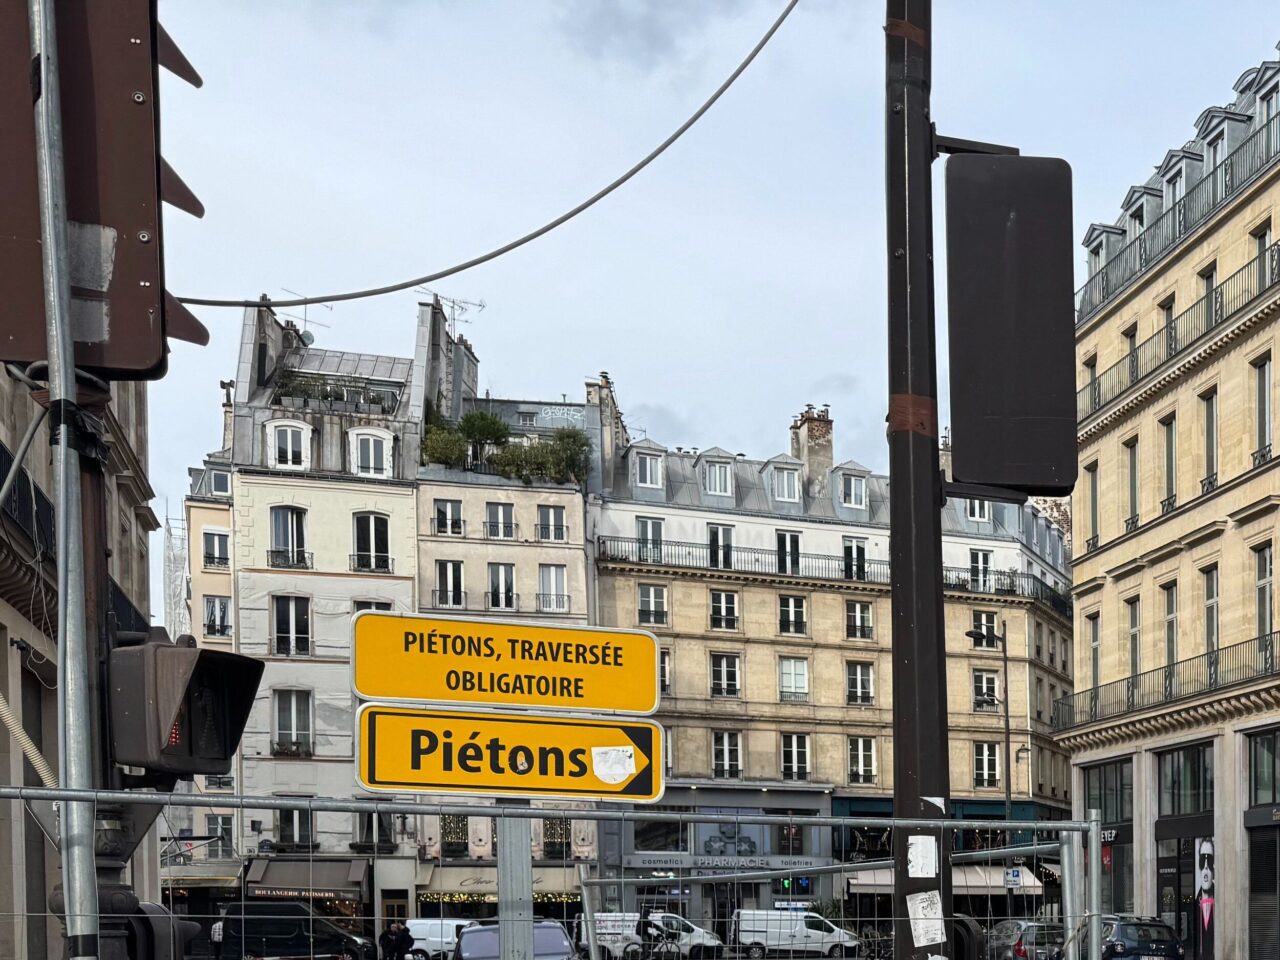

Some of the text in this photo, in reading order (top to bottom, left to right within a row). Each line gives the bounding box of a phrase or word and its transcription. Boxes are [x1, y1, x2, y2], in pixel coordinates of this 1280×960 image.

[403, 629, 624, 667] PIÉTONS, TRAVERSÉE
[445, 669, 585, 698] OBLIGATOIRE
[410, 729, 588, 778] Piétons
[699, 857, 765, 867] PHARMACIE
